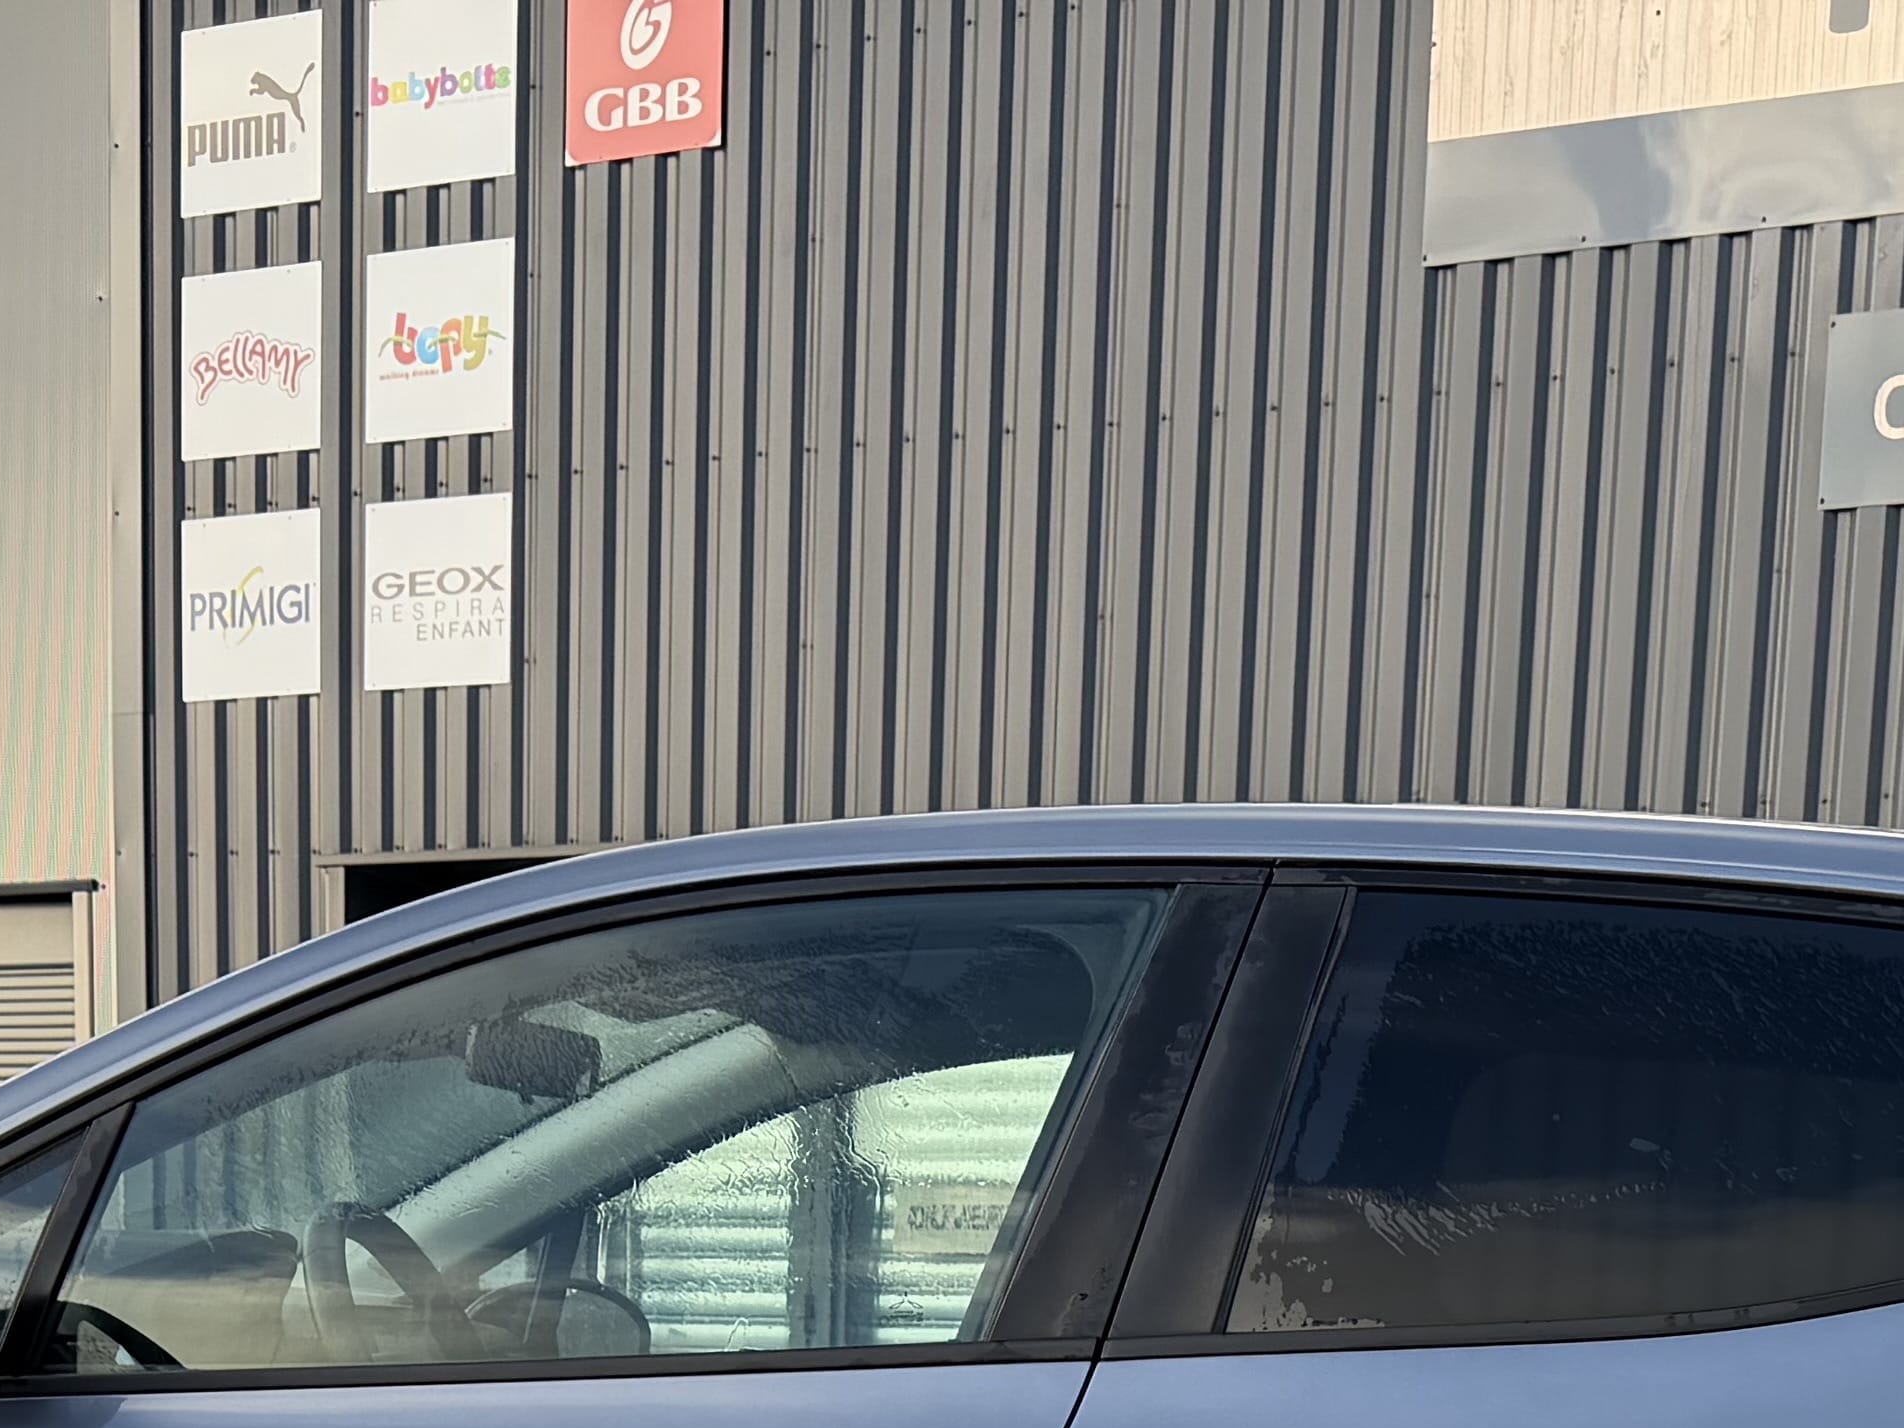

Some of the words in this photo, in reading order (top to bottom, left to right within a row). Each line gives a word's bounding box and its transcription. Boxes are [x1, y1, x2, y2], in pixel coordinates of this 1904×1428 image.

[584, 76, 704, 132] GBB
[187, 111, 286, 168] PUMA
[393, 312, 489, 374] bopy
[189, 582, 311, 632] PRIMIGI
[372, 564, 505, 600] GEOX
[370, 596, 505, 625] RESPIRA
[416, 617, 505, 643] ENFANT
